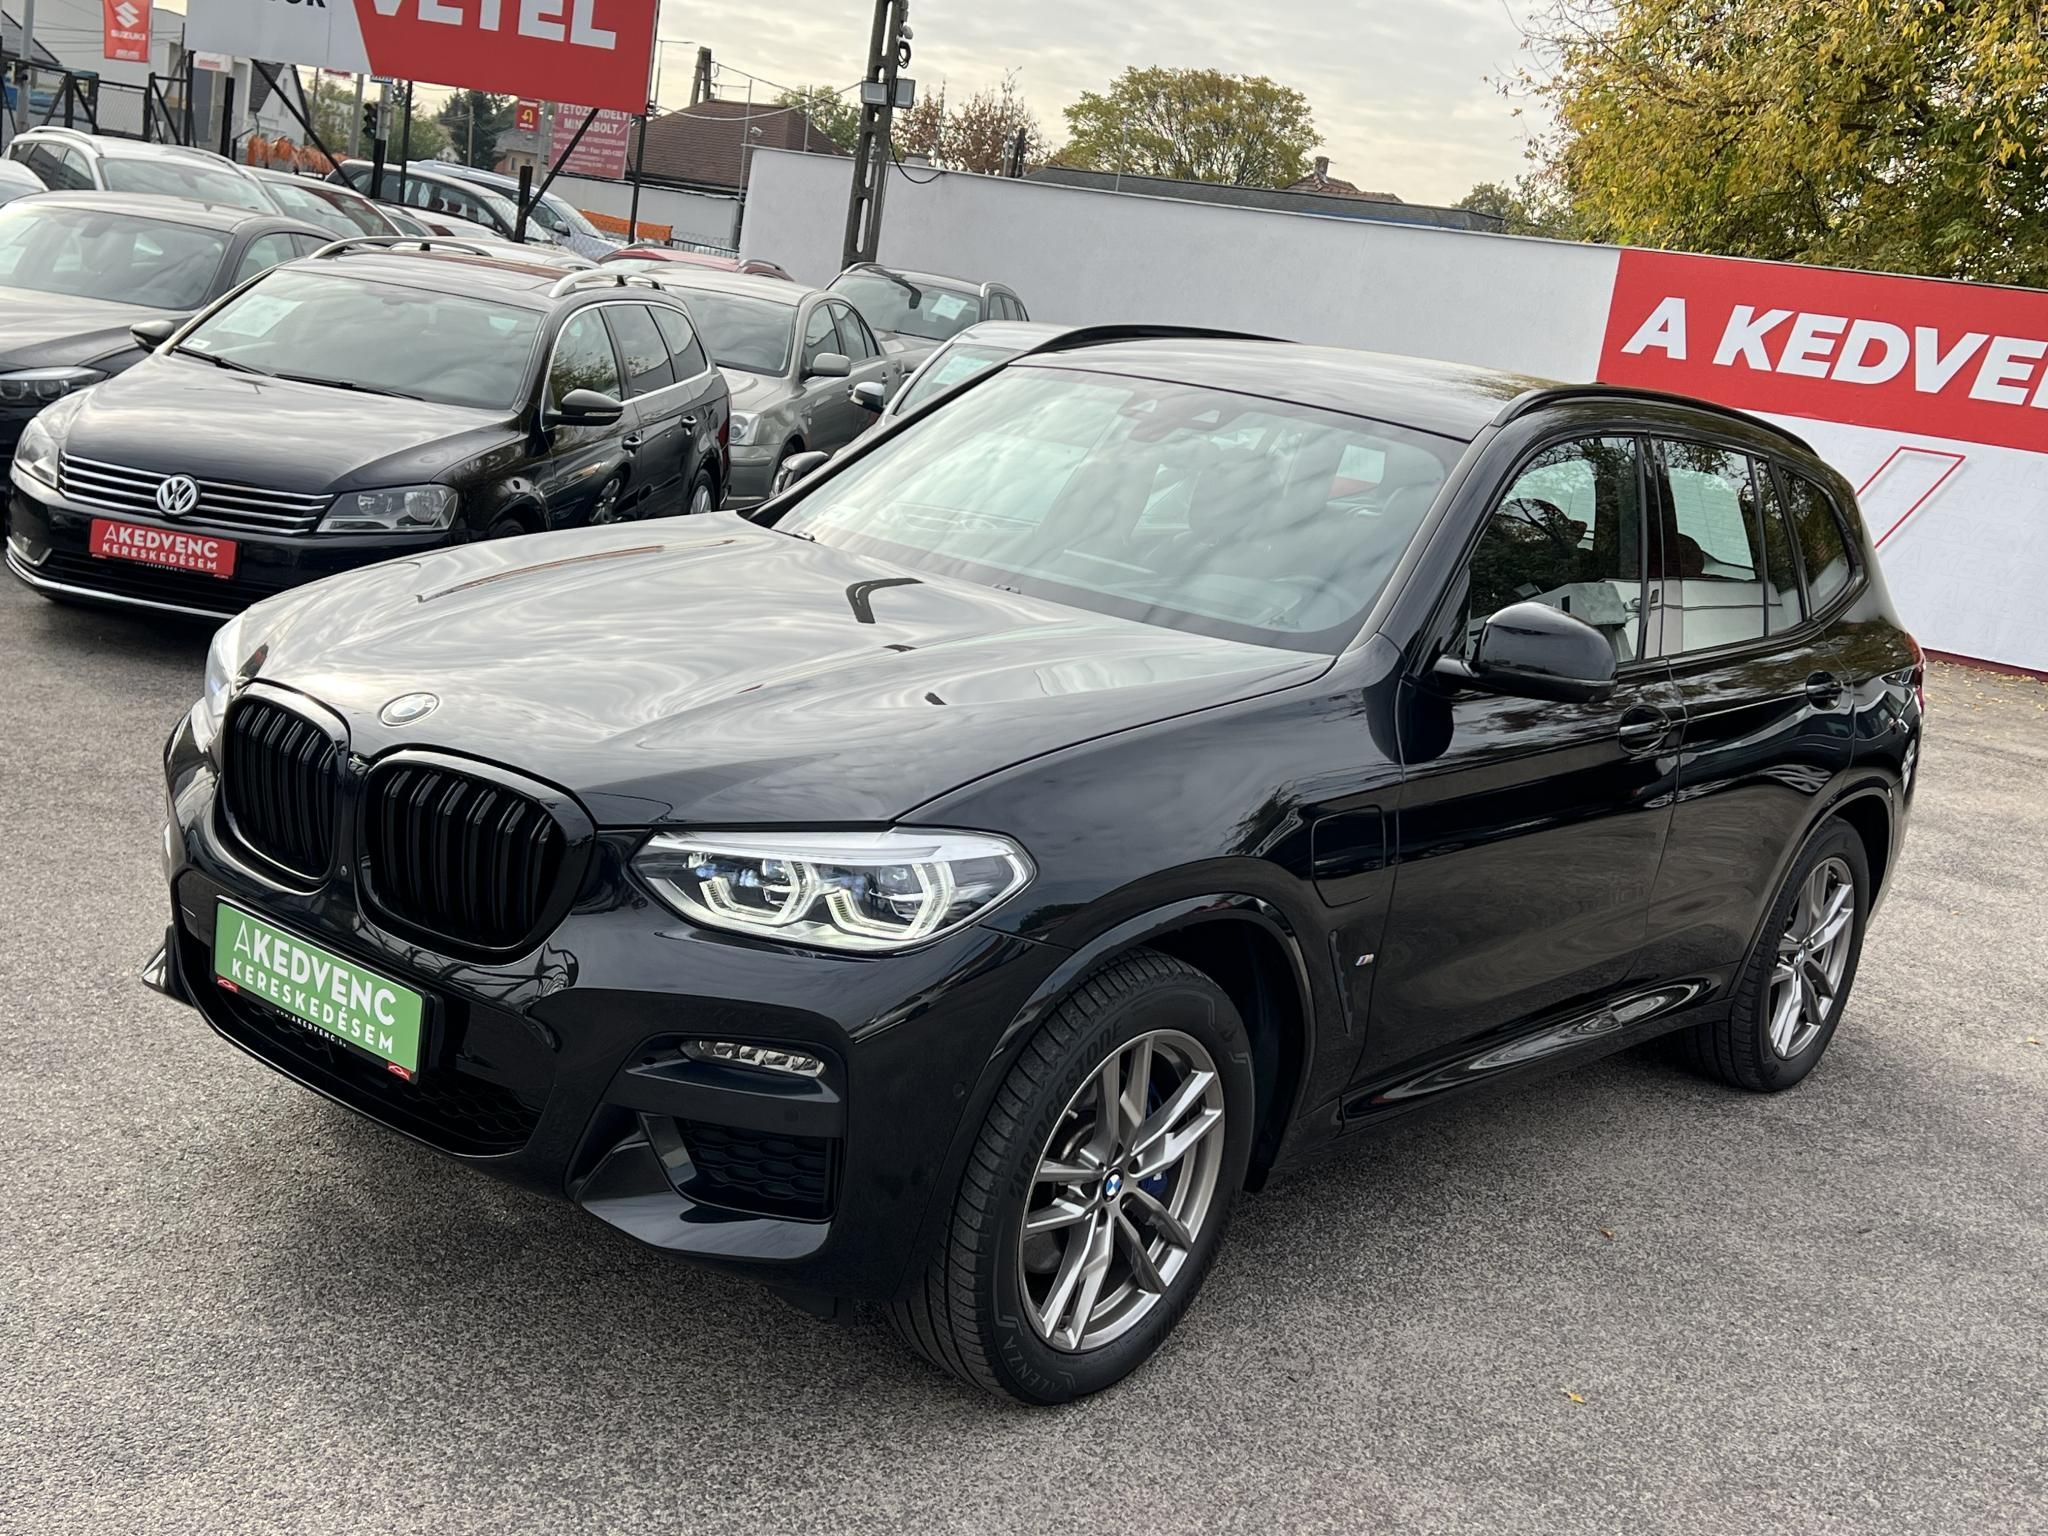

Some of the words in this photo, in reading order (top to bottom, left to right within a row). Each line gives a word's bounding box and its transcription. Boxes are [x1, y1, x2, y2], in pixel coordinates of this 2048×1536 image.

[564, 118, 619, 135] MINABOLT
[1621, 296, 1688, 361] A
[1713, 304, 2048, 410] KEDVE
[102, 542, 217, 570] KERESKEDÉSEM
[231, 958, 394, 1054] KERESKEDÉSEM
